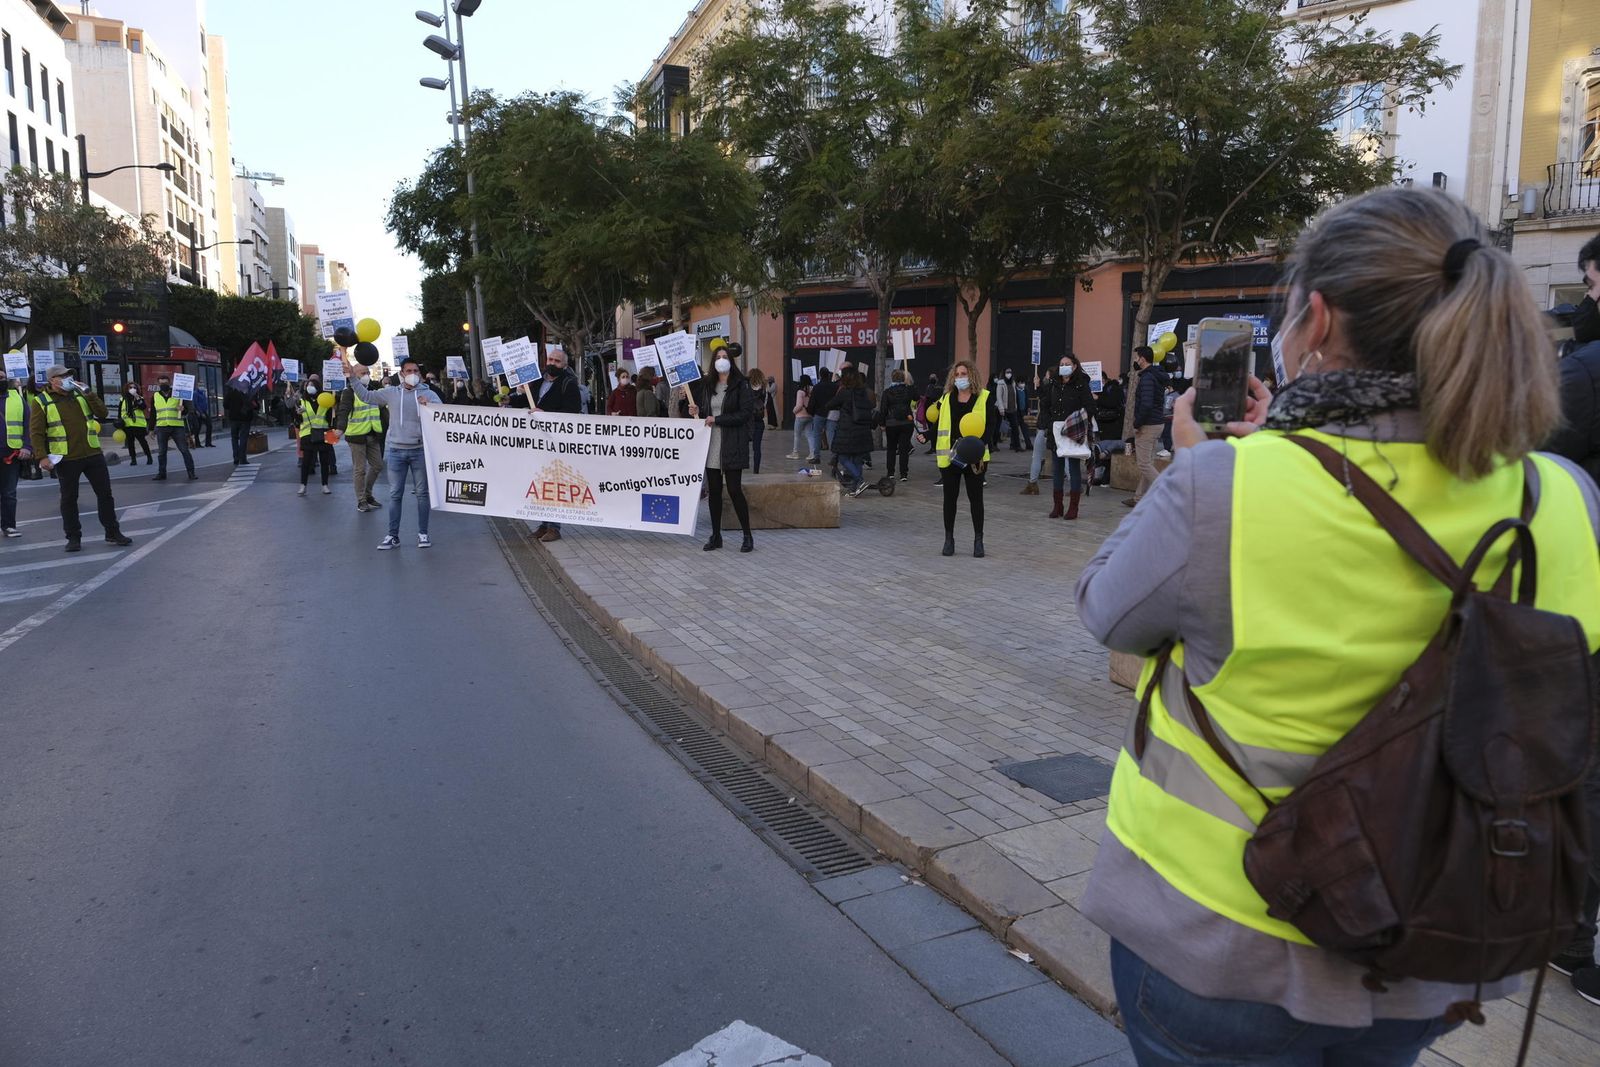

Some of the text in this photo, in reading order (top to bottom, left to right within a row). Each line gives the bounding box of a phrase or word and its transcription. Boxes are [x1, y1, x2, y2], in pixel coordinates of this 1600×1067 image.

[796, 324, 852, 336] LOCAL EN
[795, 335, 853, 347] ALQUILER
[433, 411, 509, 428] PARALIZACIÓN
[512, 417, 527, 430] DE
[577, 423, 591, 435] DE
[595, 424, 641, 438] EMPLEO
[644, 424, 695, 441] PÚBLICO
[446, 431, 680, 460] ESPAÑA INCUMPLE LA DIRECTIVA 1999/70/CE
[438, 458, 485, 473] #FijezaYA
[463, 483, 485, 494] #15F
[598, 473, 703, 493] #ContigoYlosTuyos
[525, 480, 596, 505] AEEPA
